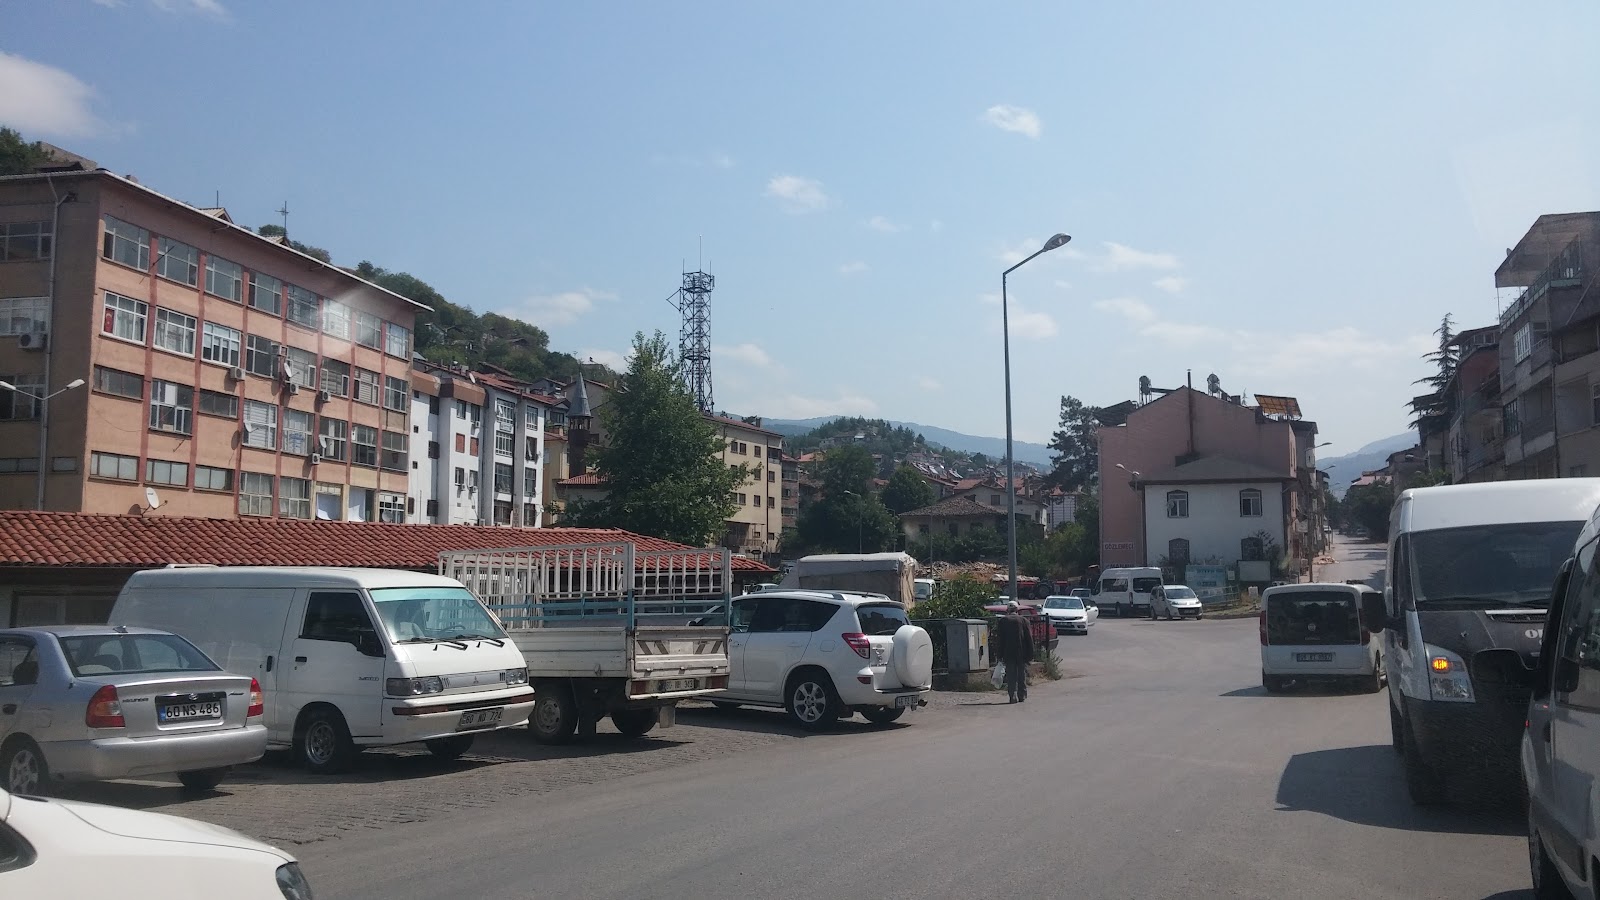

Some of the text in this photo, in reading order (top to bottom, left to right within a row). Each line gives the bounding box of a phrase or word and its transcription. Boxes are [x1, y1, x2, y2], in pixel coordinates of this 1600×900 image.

[166, 702, 219, 718] 60 NS 486
